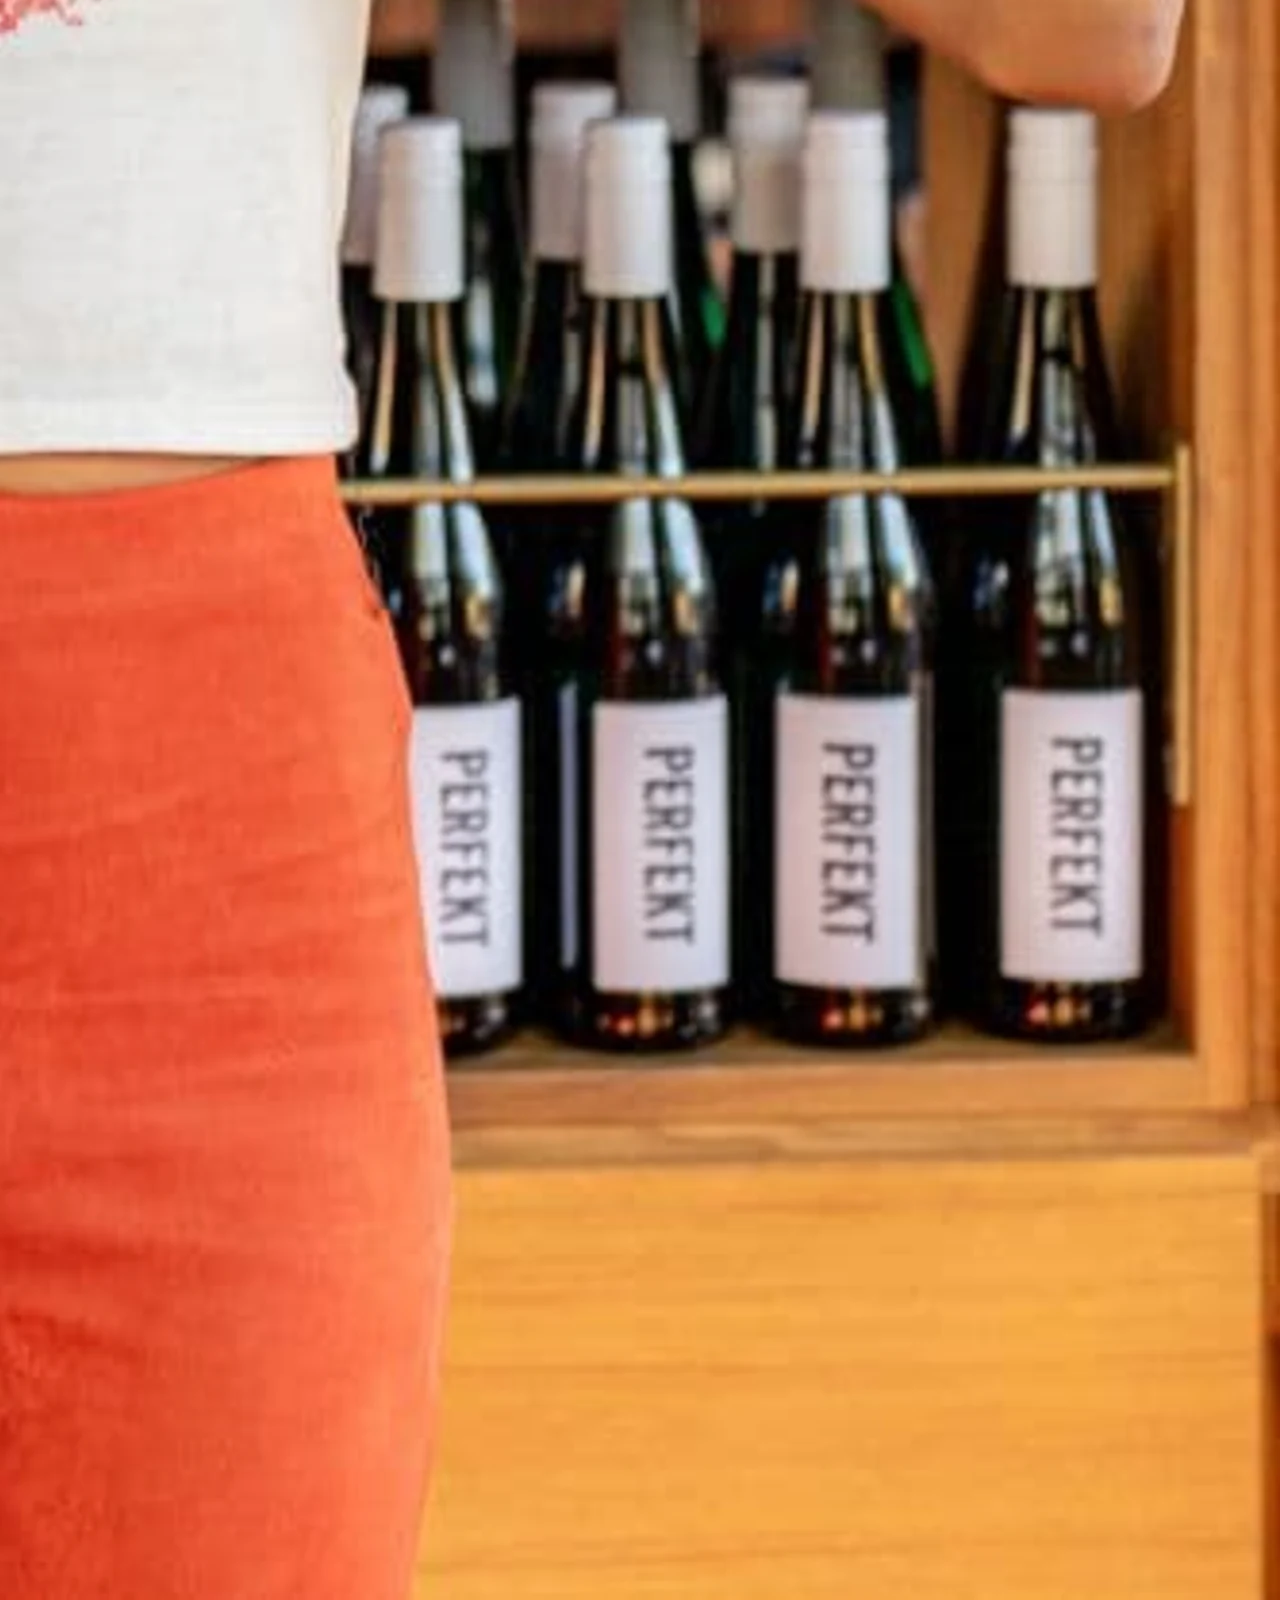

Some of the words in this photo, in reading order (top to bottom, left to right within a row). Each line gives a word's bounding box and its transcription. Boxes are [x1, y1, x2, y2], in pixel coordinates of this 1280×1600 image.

[440, 749, 488, 947] PERFEKT
[643, 746, 694, 945] PERFEKT
[820, 742, 875, 946] PERFEKT
[1050, 736, 1104, 939] PERFEKT
